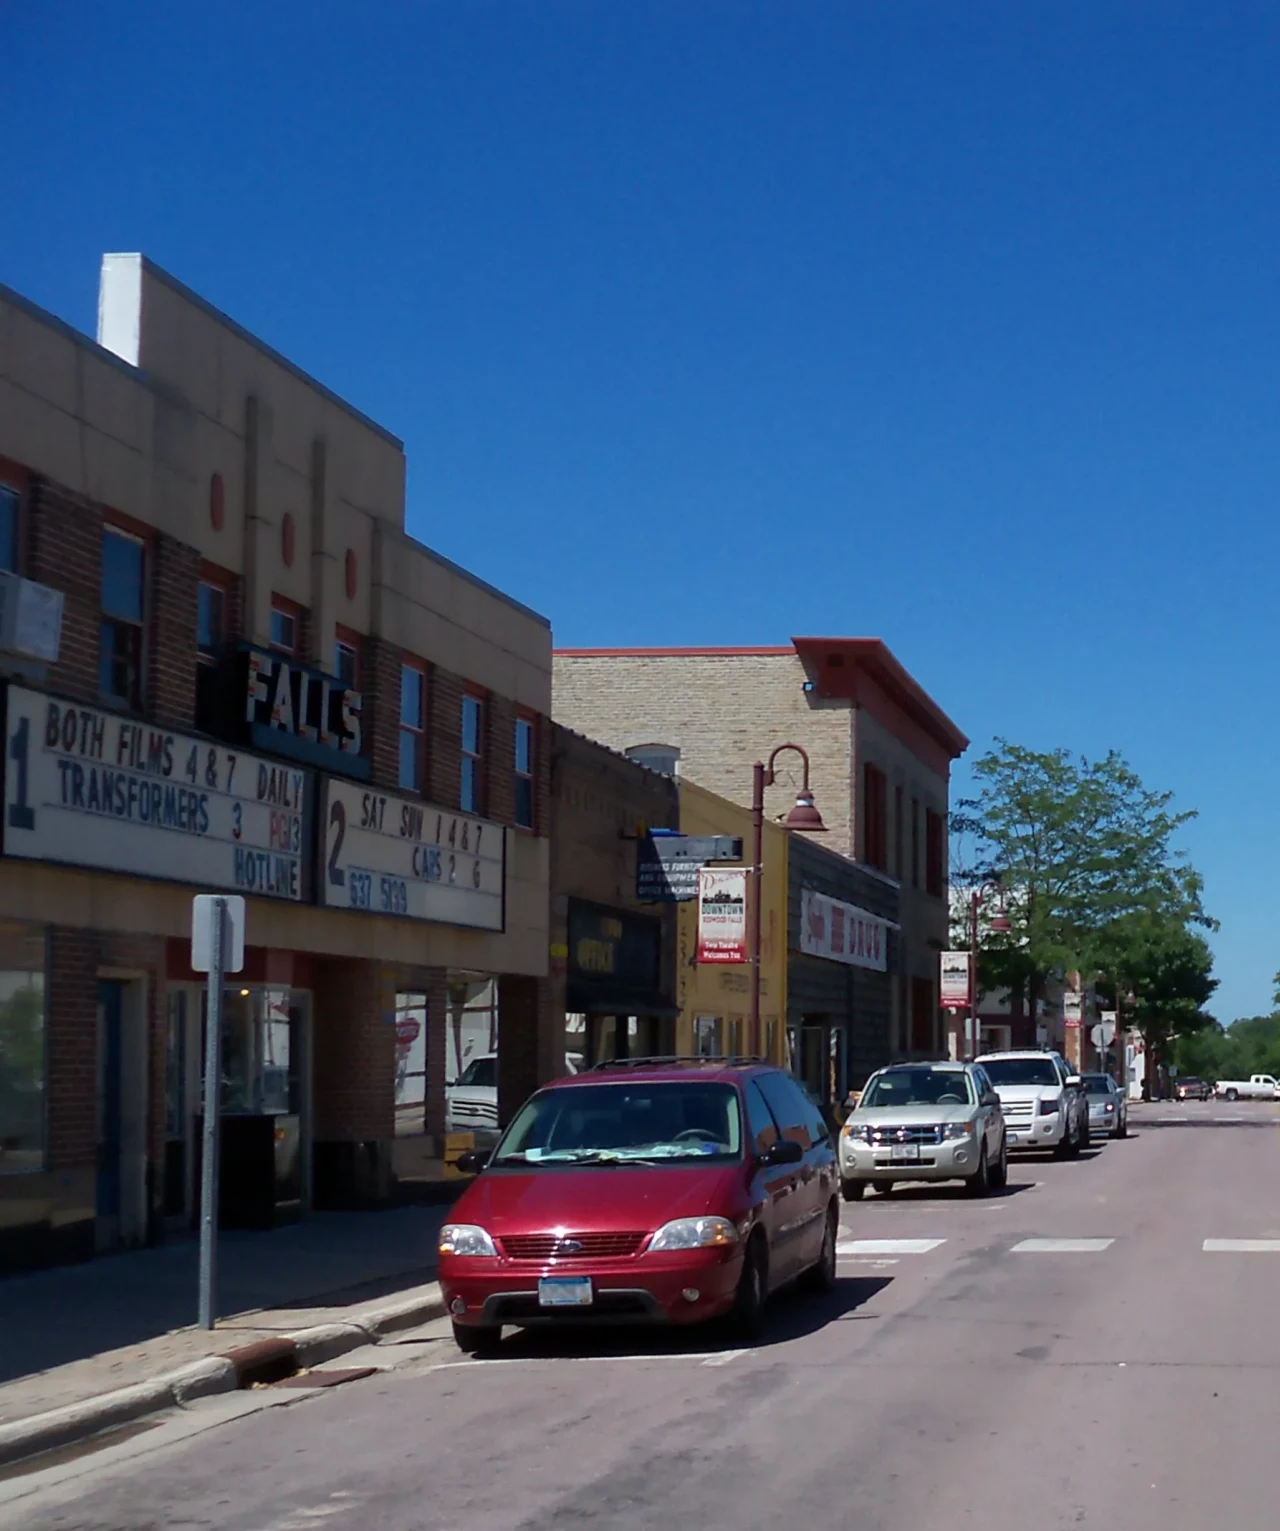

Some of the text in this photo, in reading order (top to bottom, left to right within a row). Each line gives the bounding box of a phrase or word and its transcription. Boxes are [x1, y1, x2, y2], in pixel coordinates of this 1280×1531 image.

[246, 650, 363, 754] FALLS
[9, 716, 35, 830] 1
[45, 702, 302, 809] BOTH FILMS 4 & 7 DAILY
[57, 759, 208, 833] TRANSFORMERS
[232, 802, 243, 839] 3
[361, 793, 386, 830] SAT
[401, 804, 424, 841] SUN
[449, 818, 457, 848] 4
[476, 825, 482, 854] 7
[234, 848, 298, 896] HOTLINE
[328, 800, 346, 887] 2
[350, 871, 372, 908] 637
[702, 904, 744, 915] DOWNTOWN
